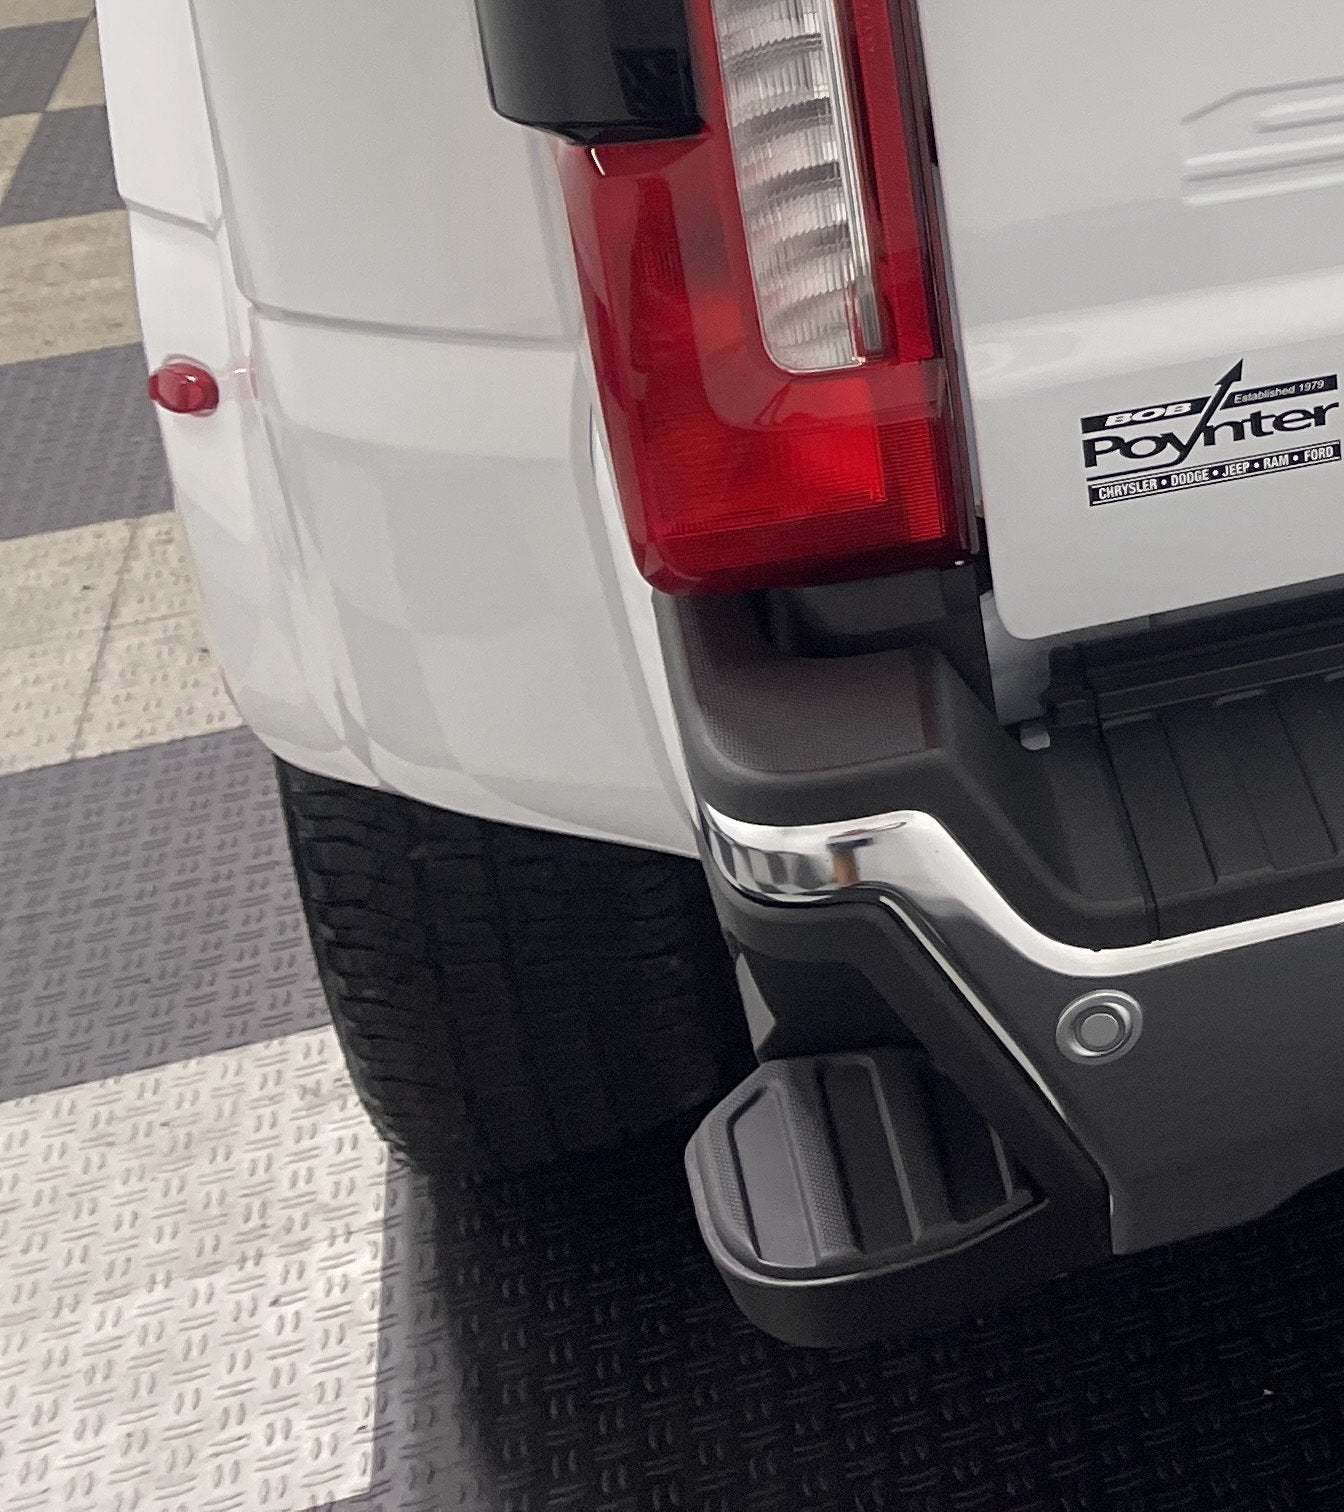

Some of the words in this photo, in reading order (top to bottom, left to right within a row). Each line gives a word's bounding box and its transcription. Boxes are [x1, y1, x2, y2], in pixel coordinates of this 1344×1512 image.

[1233, 384, 1297, 404] Established
[1298, 379, 1325, 393] 1979
[1104, 401, 1193, 428] BOB
[1081, 399, 1340, 474] Poynter
[1098, 477, 1158, 501] CHRYSLER
[1170, 468, 1210, 488] DODGE
[1221, 461, 1251, 478] JEEP
[1262, 453, 1290, 471] RAM
[1303, 445, 1335, 463] FORD
